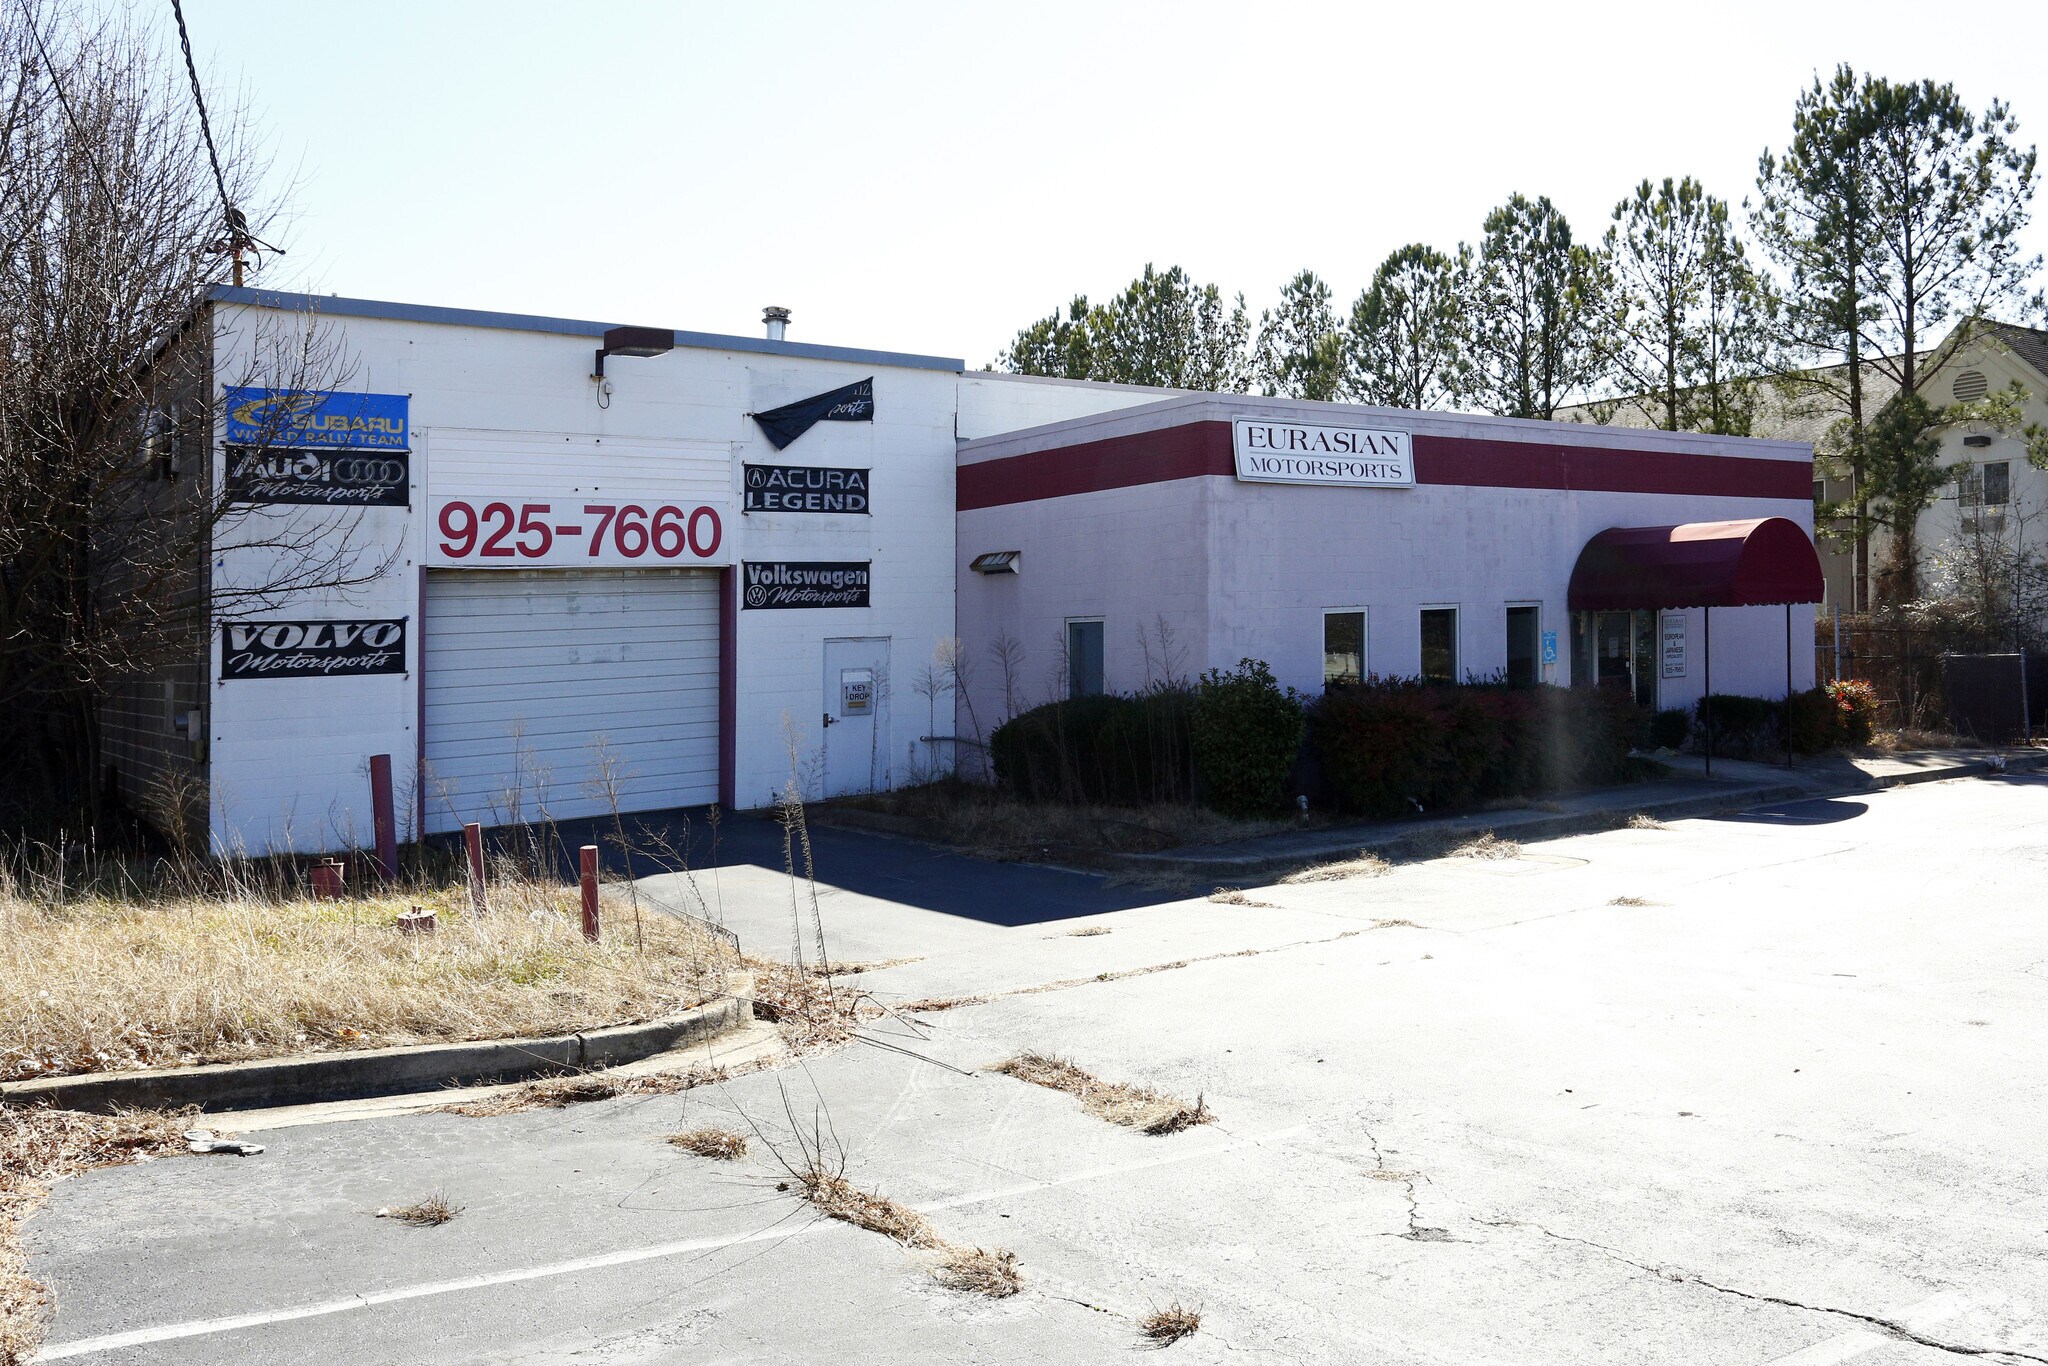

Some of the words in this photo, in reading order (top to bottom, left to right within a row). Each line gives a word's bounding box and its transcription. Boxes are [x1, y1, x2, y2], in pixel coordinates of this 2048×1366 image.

[292, 413, 404, 435] SUBARU
[305, 432, 352, 445] RALLY
[360, 434, 404, 446] TEAM
[1247, 426, 1400, 456] EURASIAN
[1250, 457, 1403, 480] MOTORSPORTS
[248, 478, 396, 503] Motorsports
[765, 469, 866, 491] ACURA
[746, 491, 866, 511] LEGEND
[438, 501, 722, 559] 925-7660
[747, 564, 868, 590] Volkswagen
[767, 586, 867, 607] Motorsports
[229, 622, 402, 651] VOLVO
[1664, 633, 1684, 641] EUROPEAN
[1665, 646, 1684, 654] JAPANESE
[227, 650, 401, 674] Motorsports
[849, 692, 870, 701] DROP
[852, 684, 866, 692] KEY
